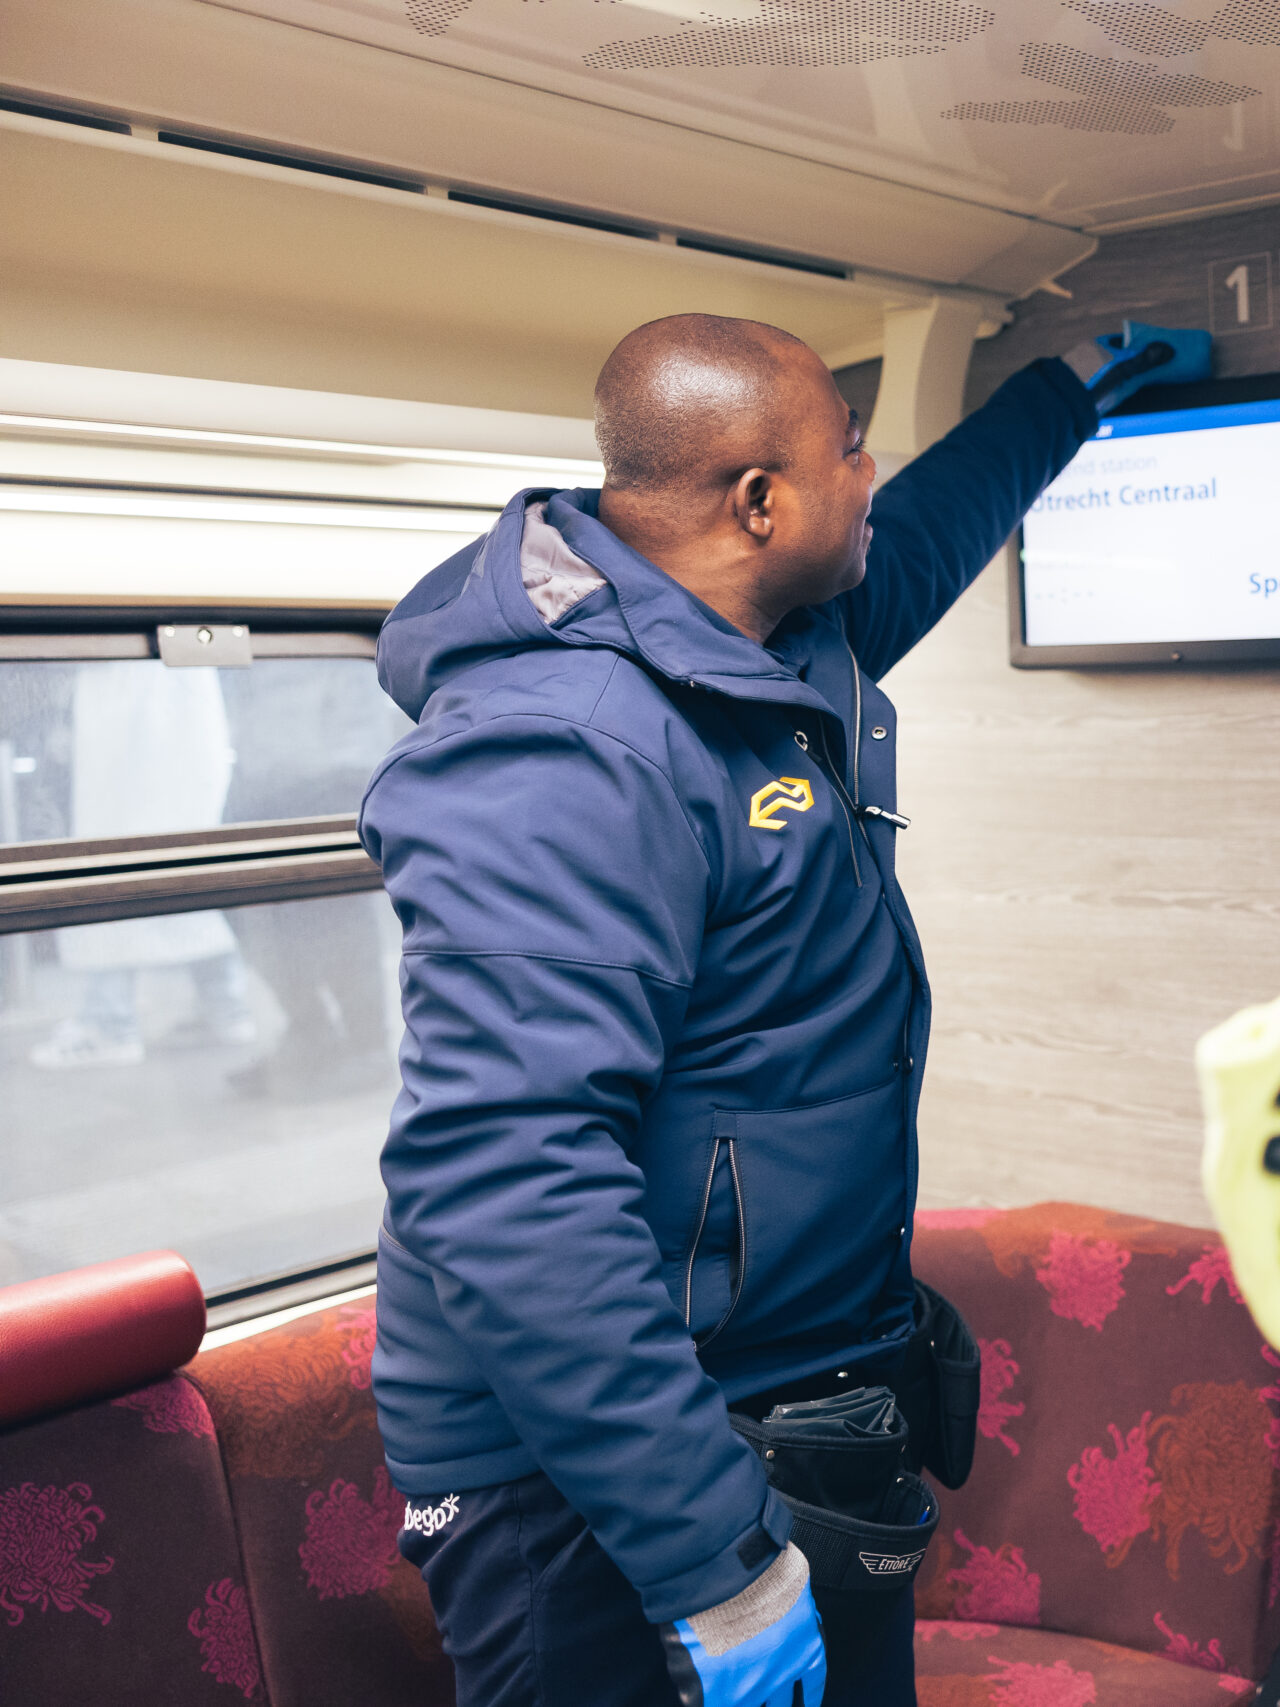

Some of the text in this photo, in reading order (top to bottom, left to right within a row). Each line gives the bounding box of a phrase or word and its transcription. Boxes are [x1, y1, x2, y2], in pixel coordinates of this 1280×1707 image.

[1225, 265, 1249, 323] 1
[1101, 455, 1158, 473] station
[1119, 478, 1218, 506] Centraal
[878, 1558, 911, 1571] ETTORE
